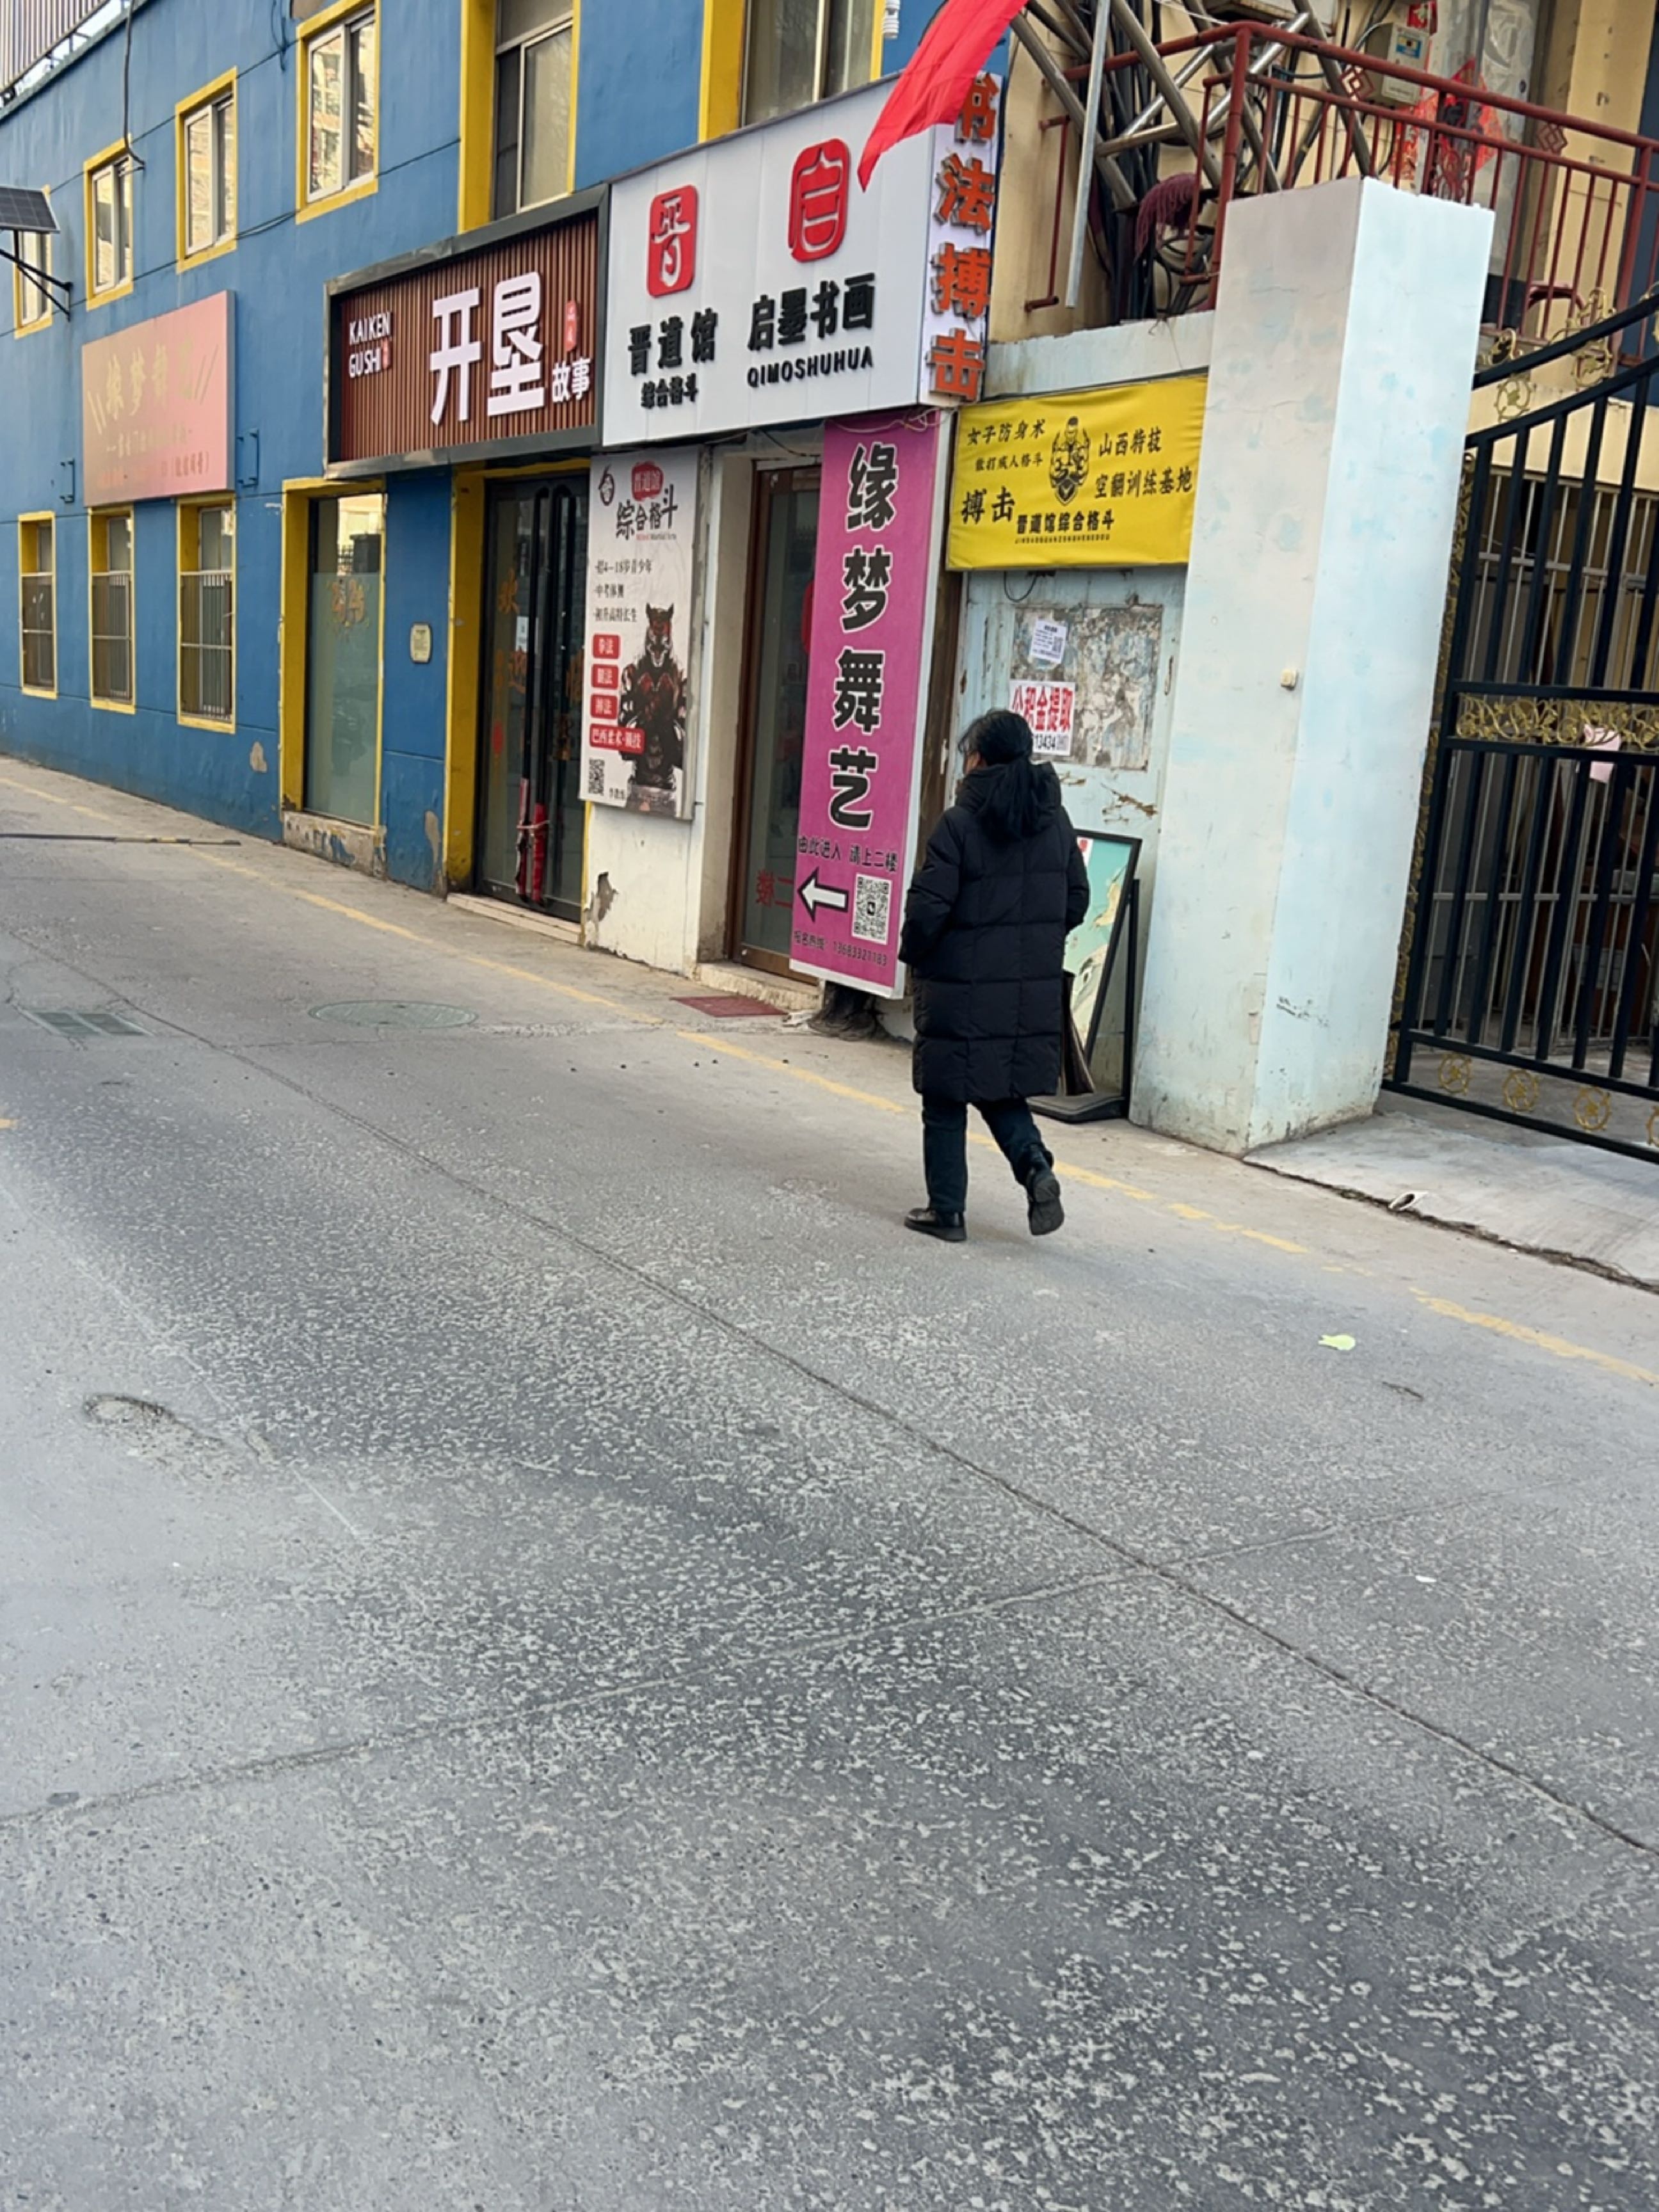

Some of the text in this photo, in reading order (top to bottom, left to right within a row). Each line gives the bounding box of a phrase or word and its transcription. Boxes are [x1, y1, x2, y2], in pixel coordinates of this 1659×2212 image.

[349, 312, 392, 346] KAIKEN
[748, 273, 875, 351] 启墨书画
[430, 271, 544, 425] 开垦
[628, 309, 718, 376] 晋道馆
[552, 357, 591, 403] 故事
[748, 346, 874, 387] QIMOSHUHUA
[967, 419, 1045, 446] 女子防身术
[1098, 426, 1162, 457] 山西特技
[1094, 465, 1193, 499] 空翻训练基地
[961, 485, 1016, 524] 搏击
[828, 442, 898, 830] 缘梦舞艺
[798, 836, 897, 872] 由此进入 请上二楼
